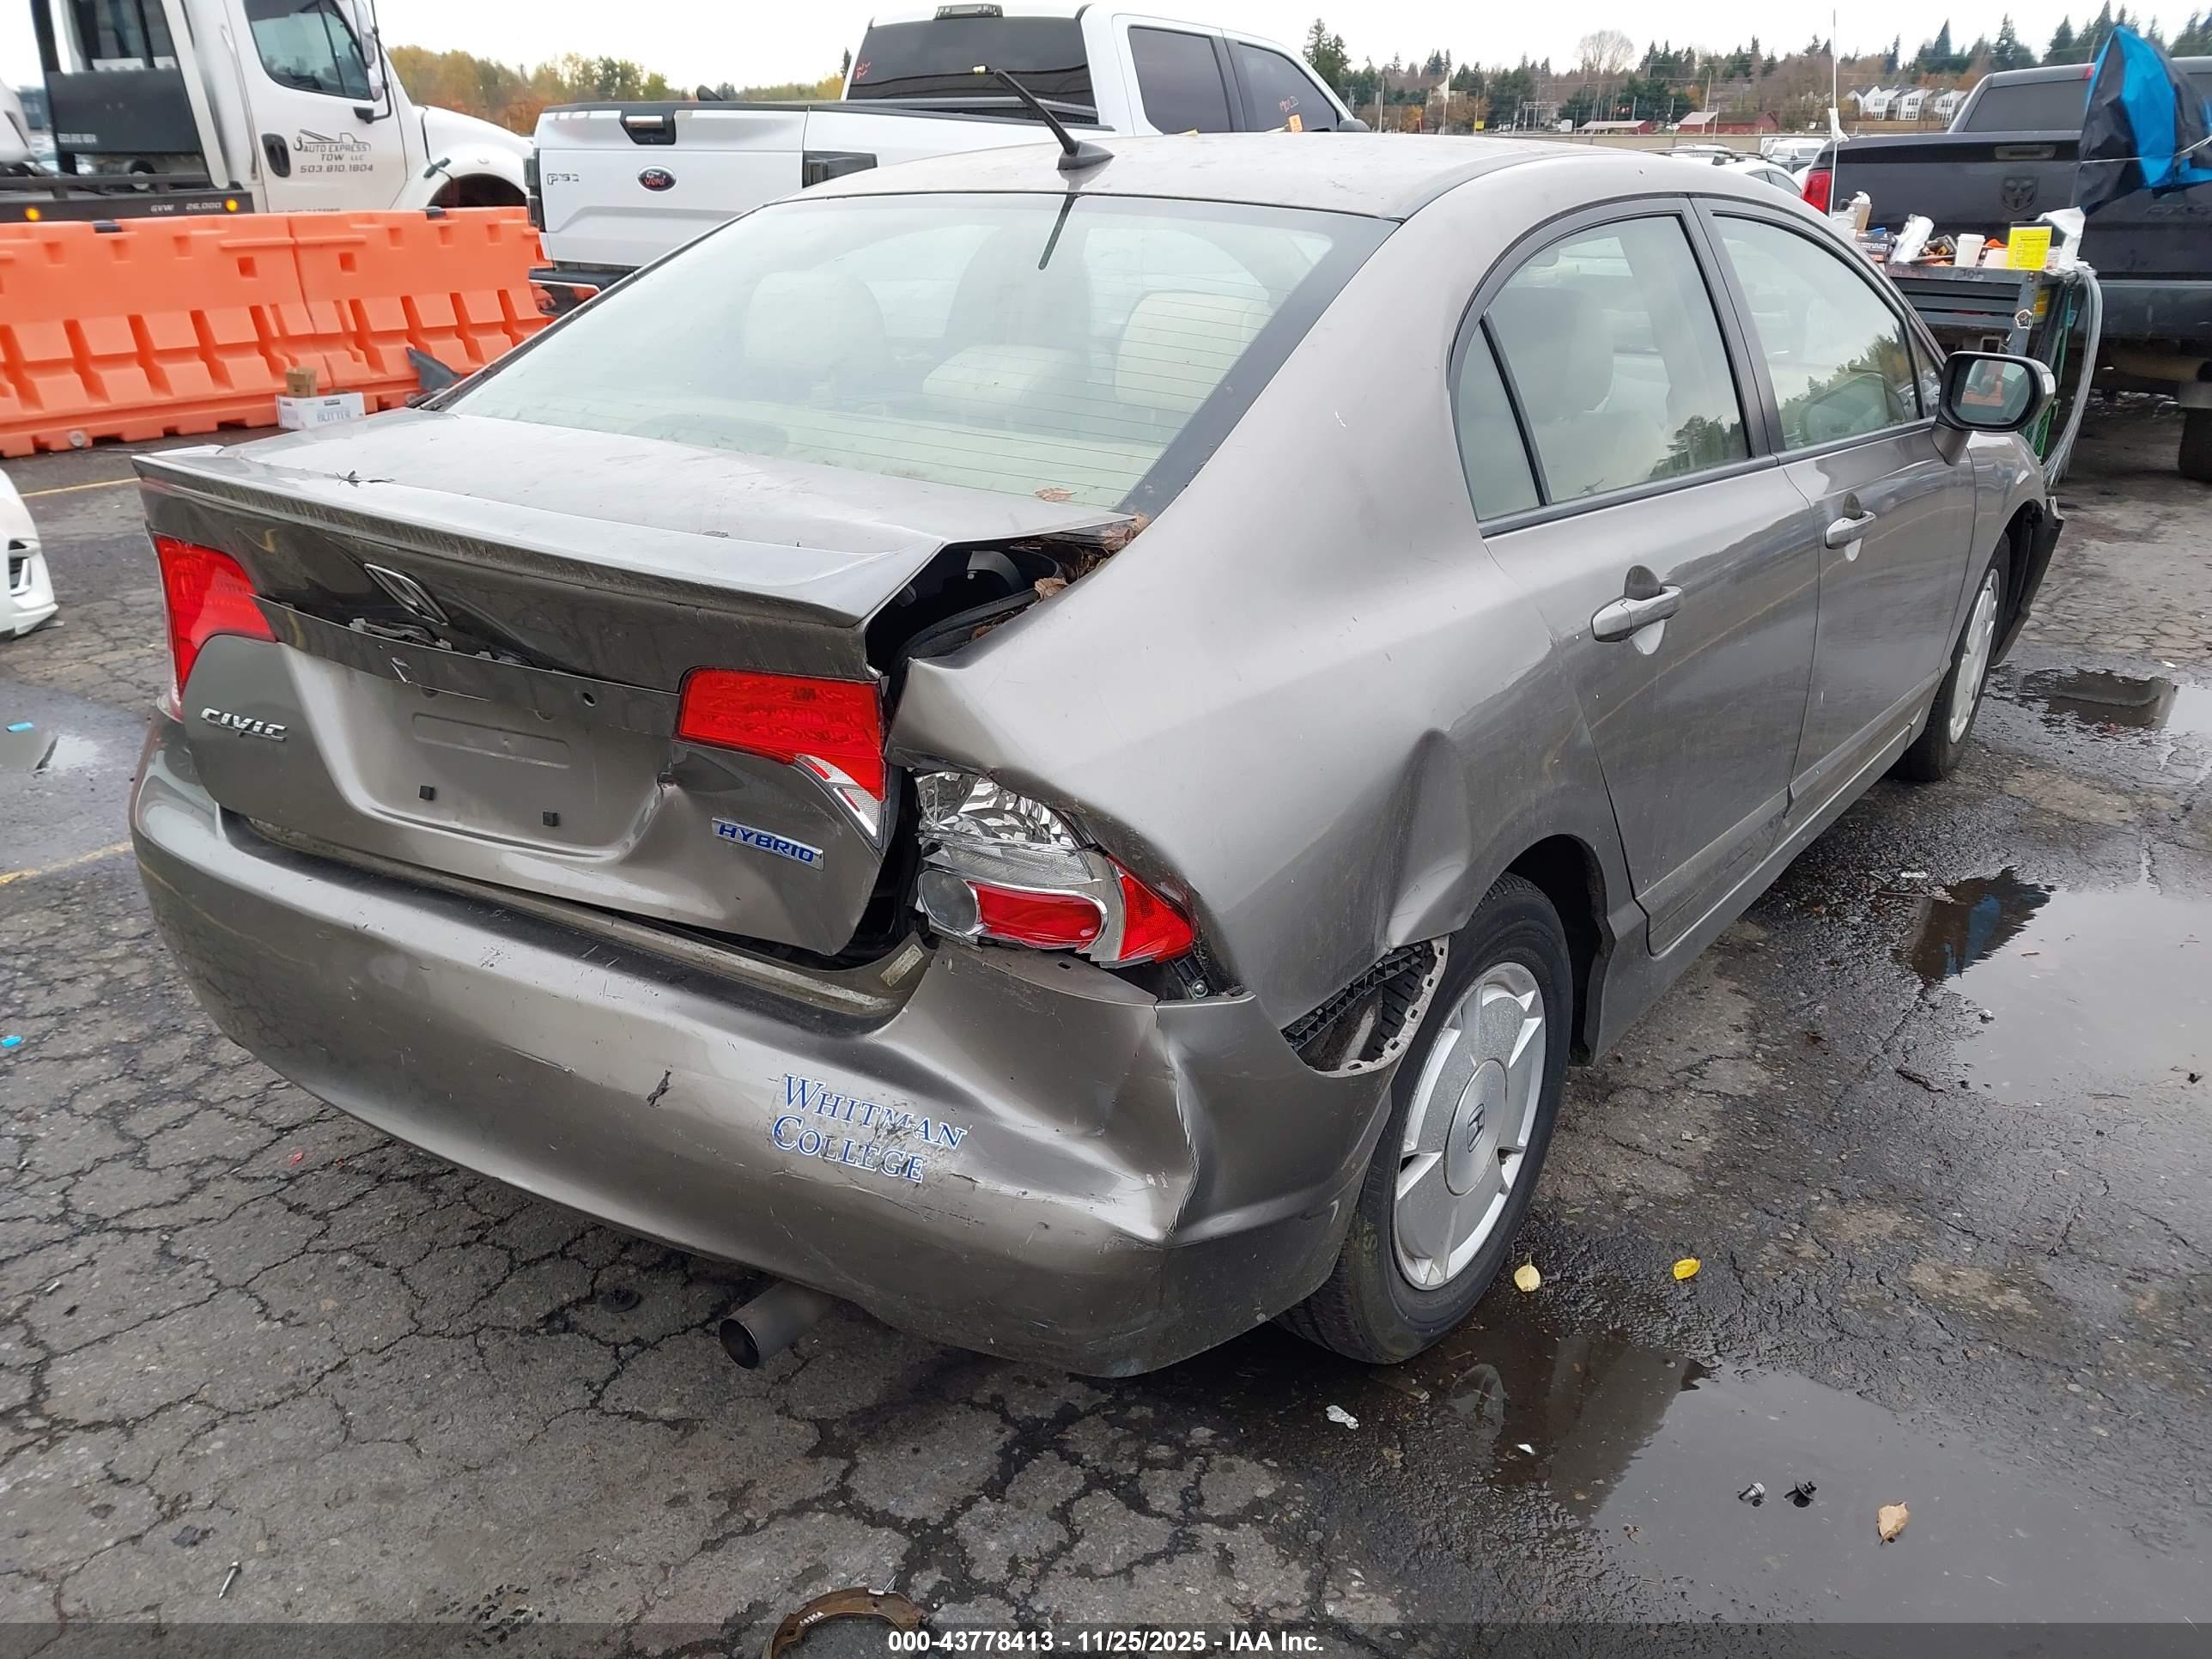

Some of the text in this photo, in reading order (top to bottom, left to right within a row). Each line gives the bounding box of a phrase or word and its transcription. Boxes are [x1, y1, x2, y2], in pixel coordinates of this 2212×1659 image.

[185, 202, 222, 210] 26,000
[200, 708, 289, 742] CIVIC
[718, 823, 815, 863] HYBRID
